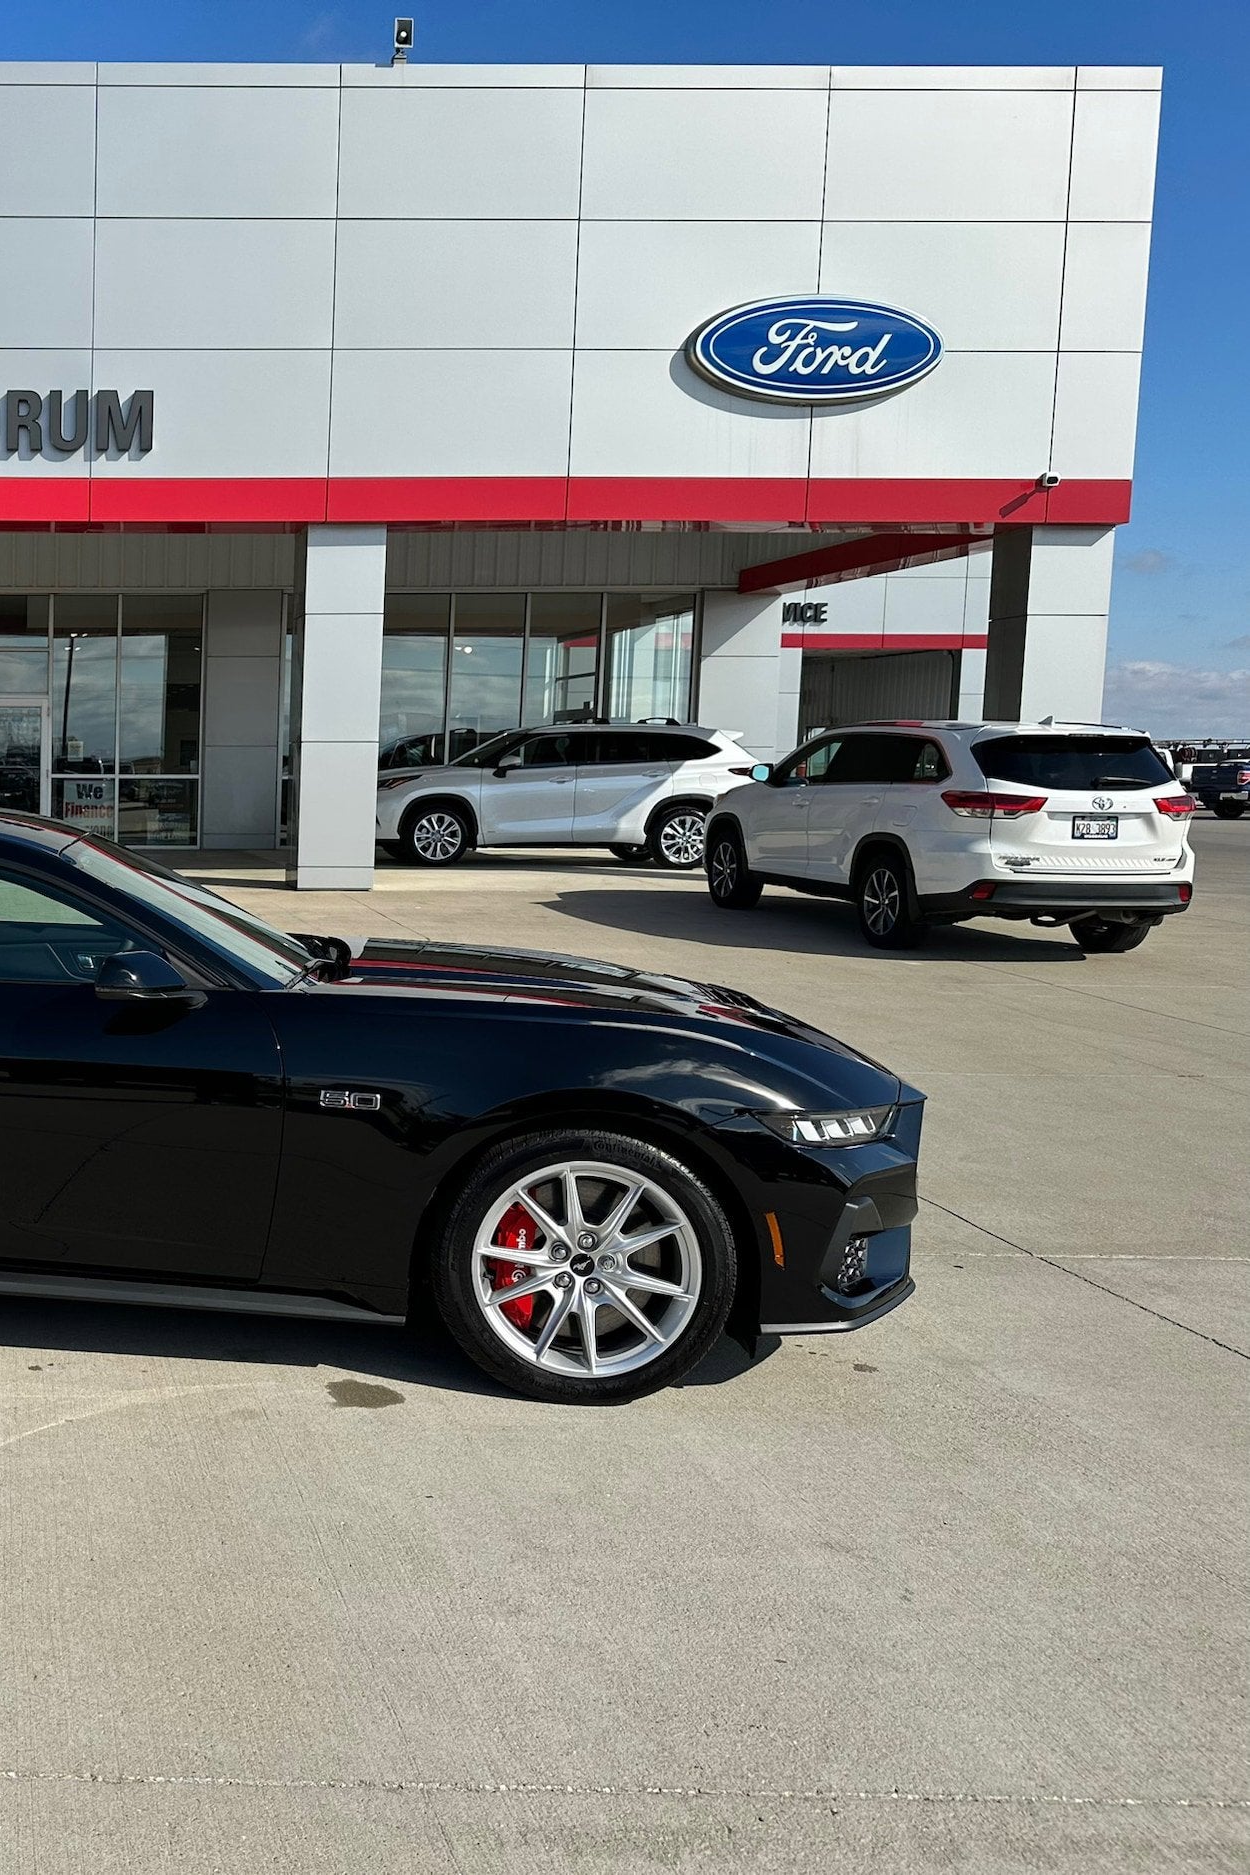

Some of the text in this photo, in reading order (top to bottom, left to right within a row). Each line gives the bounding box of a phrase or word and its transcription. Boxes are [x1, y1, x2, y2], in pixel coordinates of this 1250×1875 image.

[752, 318, 893, 375] Ford
[76, 783, 103, 799] We
[65, 801, 114, 818] Finance
[319, 1090, 381, 1111] 5.0
